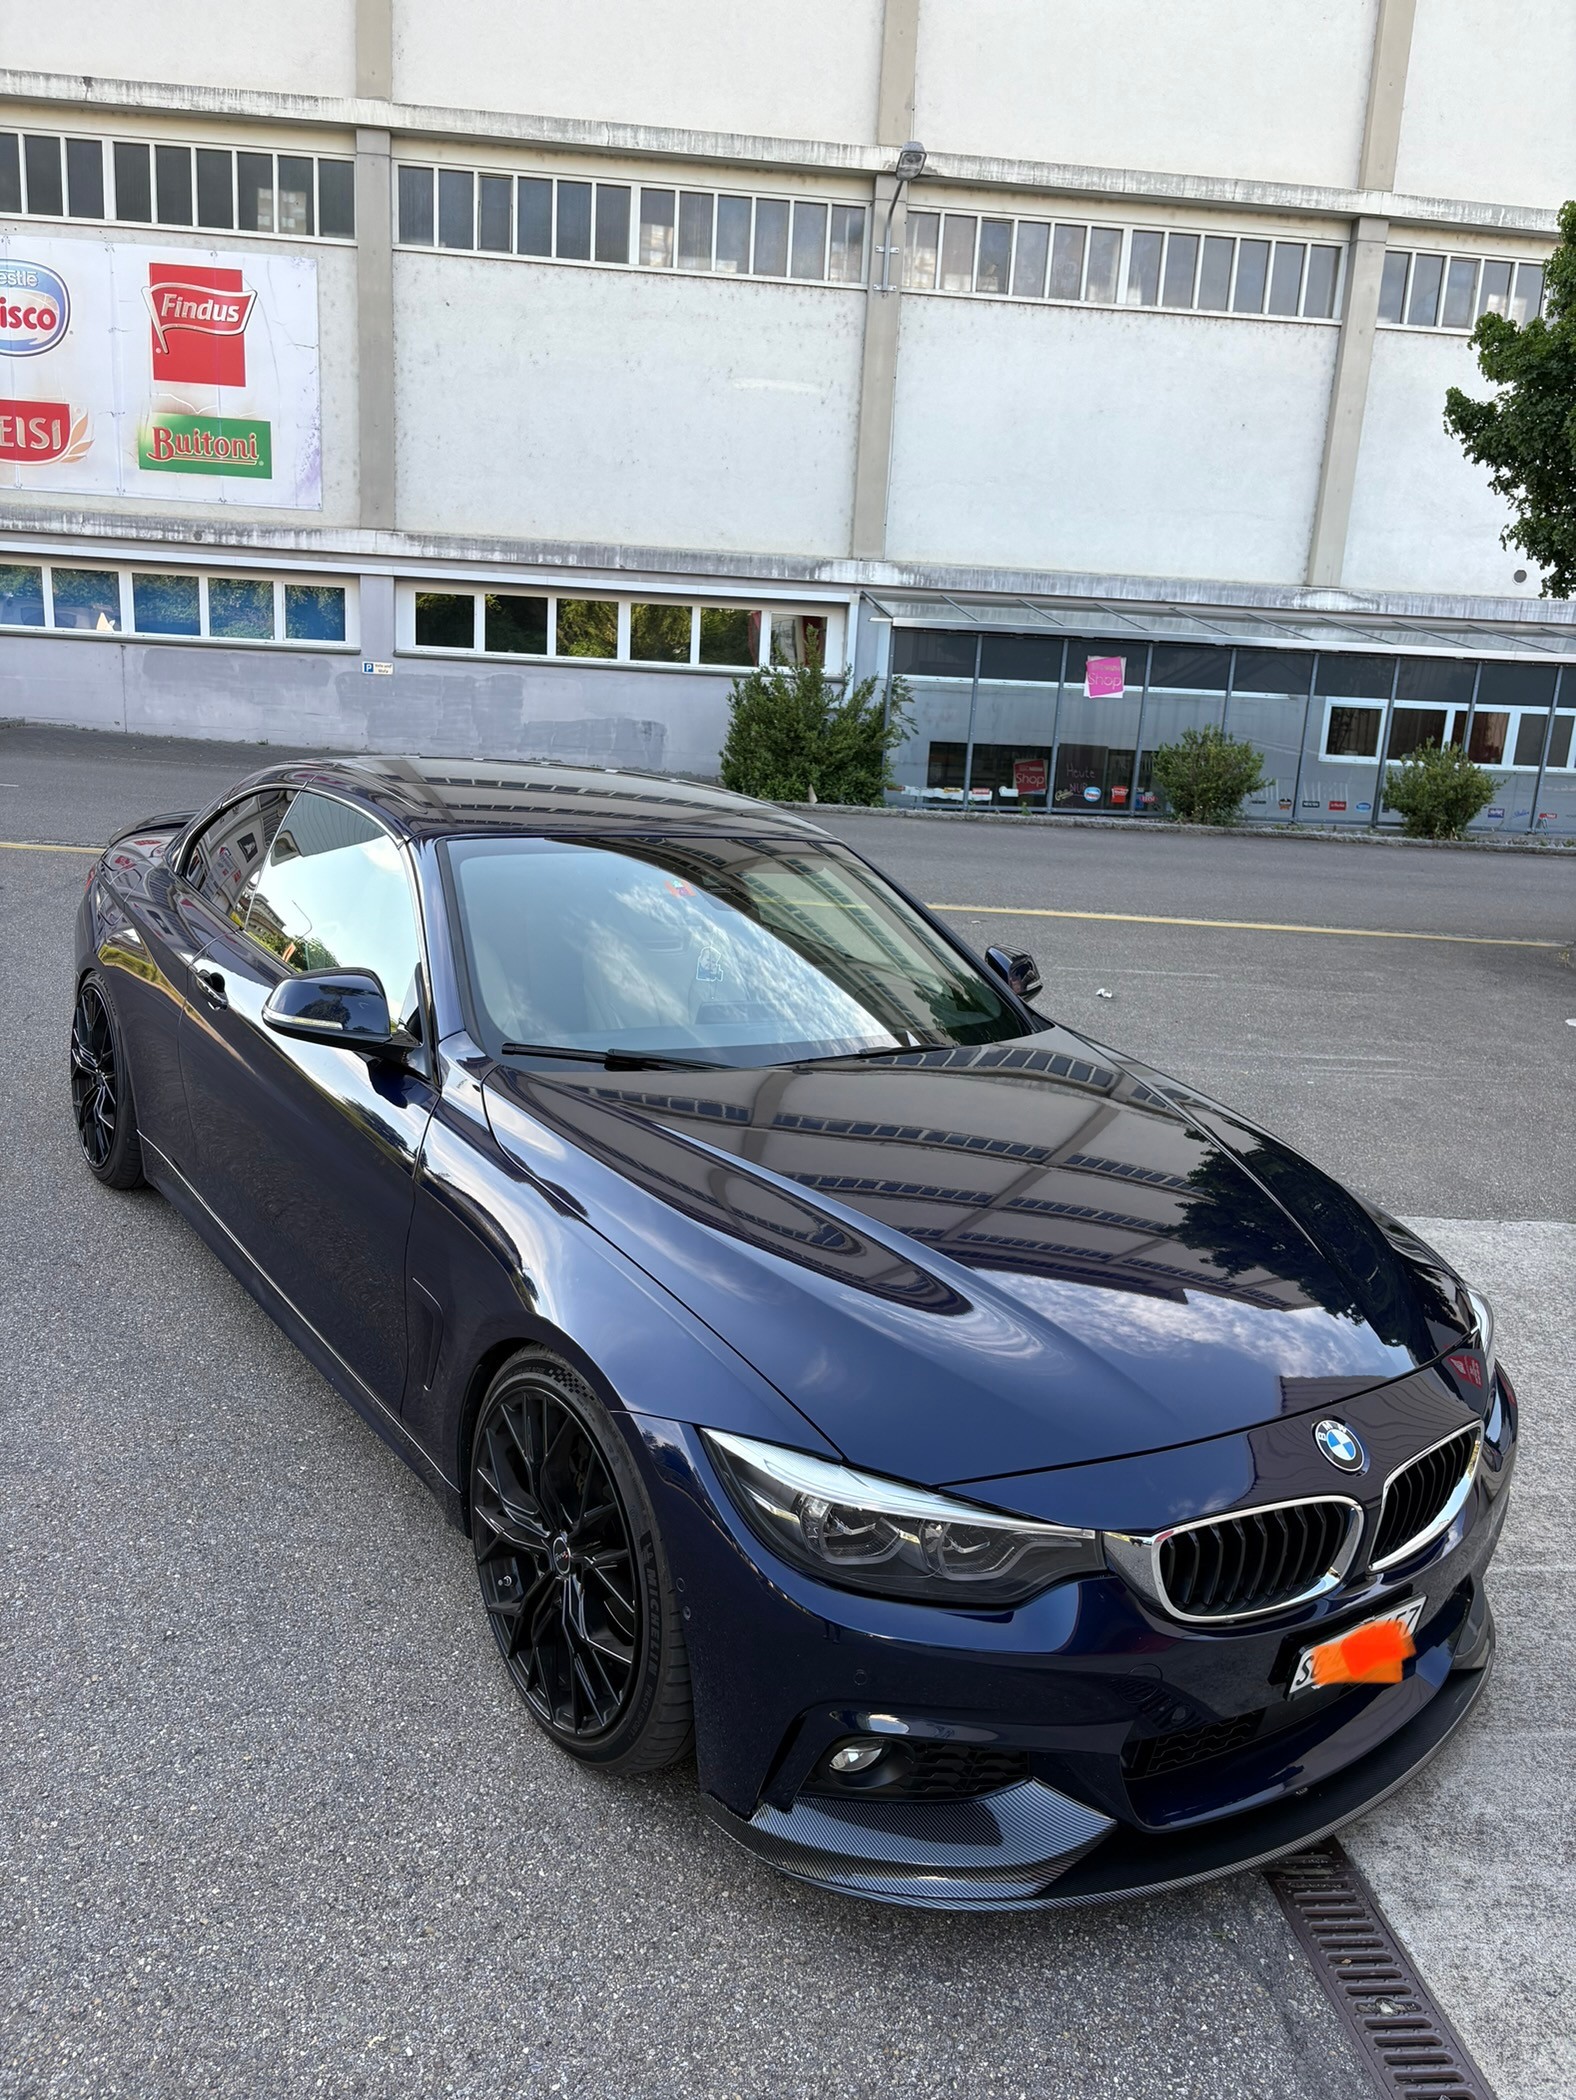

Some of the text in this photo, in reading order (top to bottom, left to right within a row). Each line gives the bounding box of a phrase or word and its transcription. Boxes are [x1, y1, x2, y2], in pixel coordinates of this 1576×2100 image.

[0, 296, 57, 331] isco
[161, 293, 239, 323] Findus
[0, 415, 61, 450] EISI
[148, 425, 259, 461] Buitoni
[1088, 672, 1122, 690] Shop
[1015, 772, 1045, 788] Shop
[1066, 762, 1095, 779] Heute
[1317, 1421, 1347, 1441] BMW
[646, 1568, 660, 1676] MICHELIN
